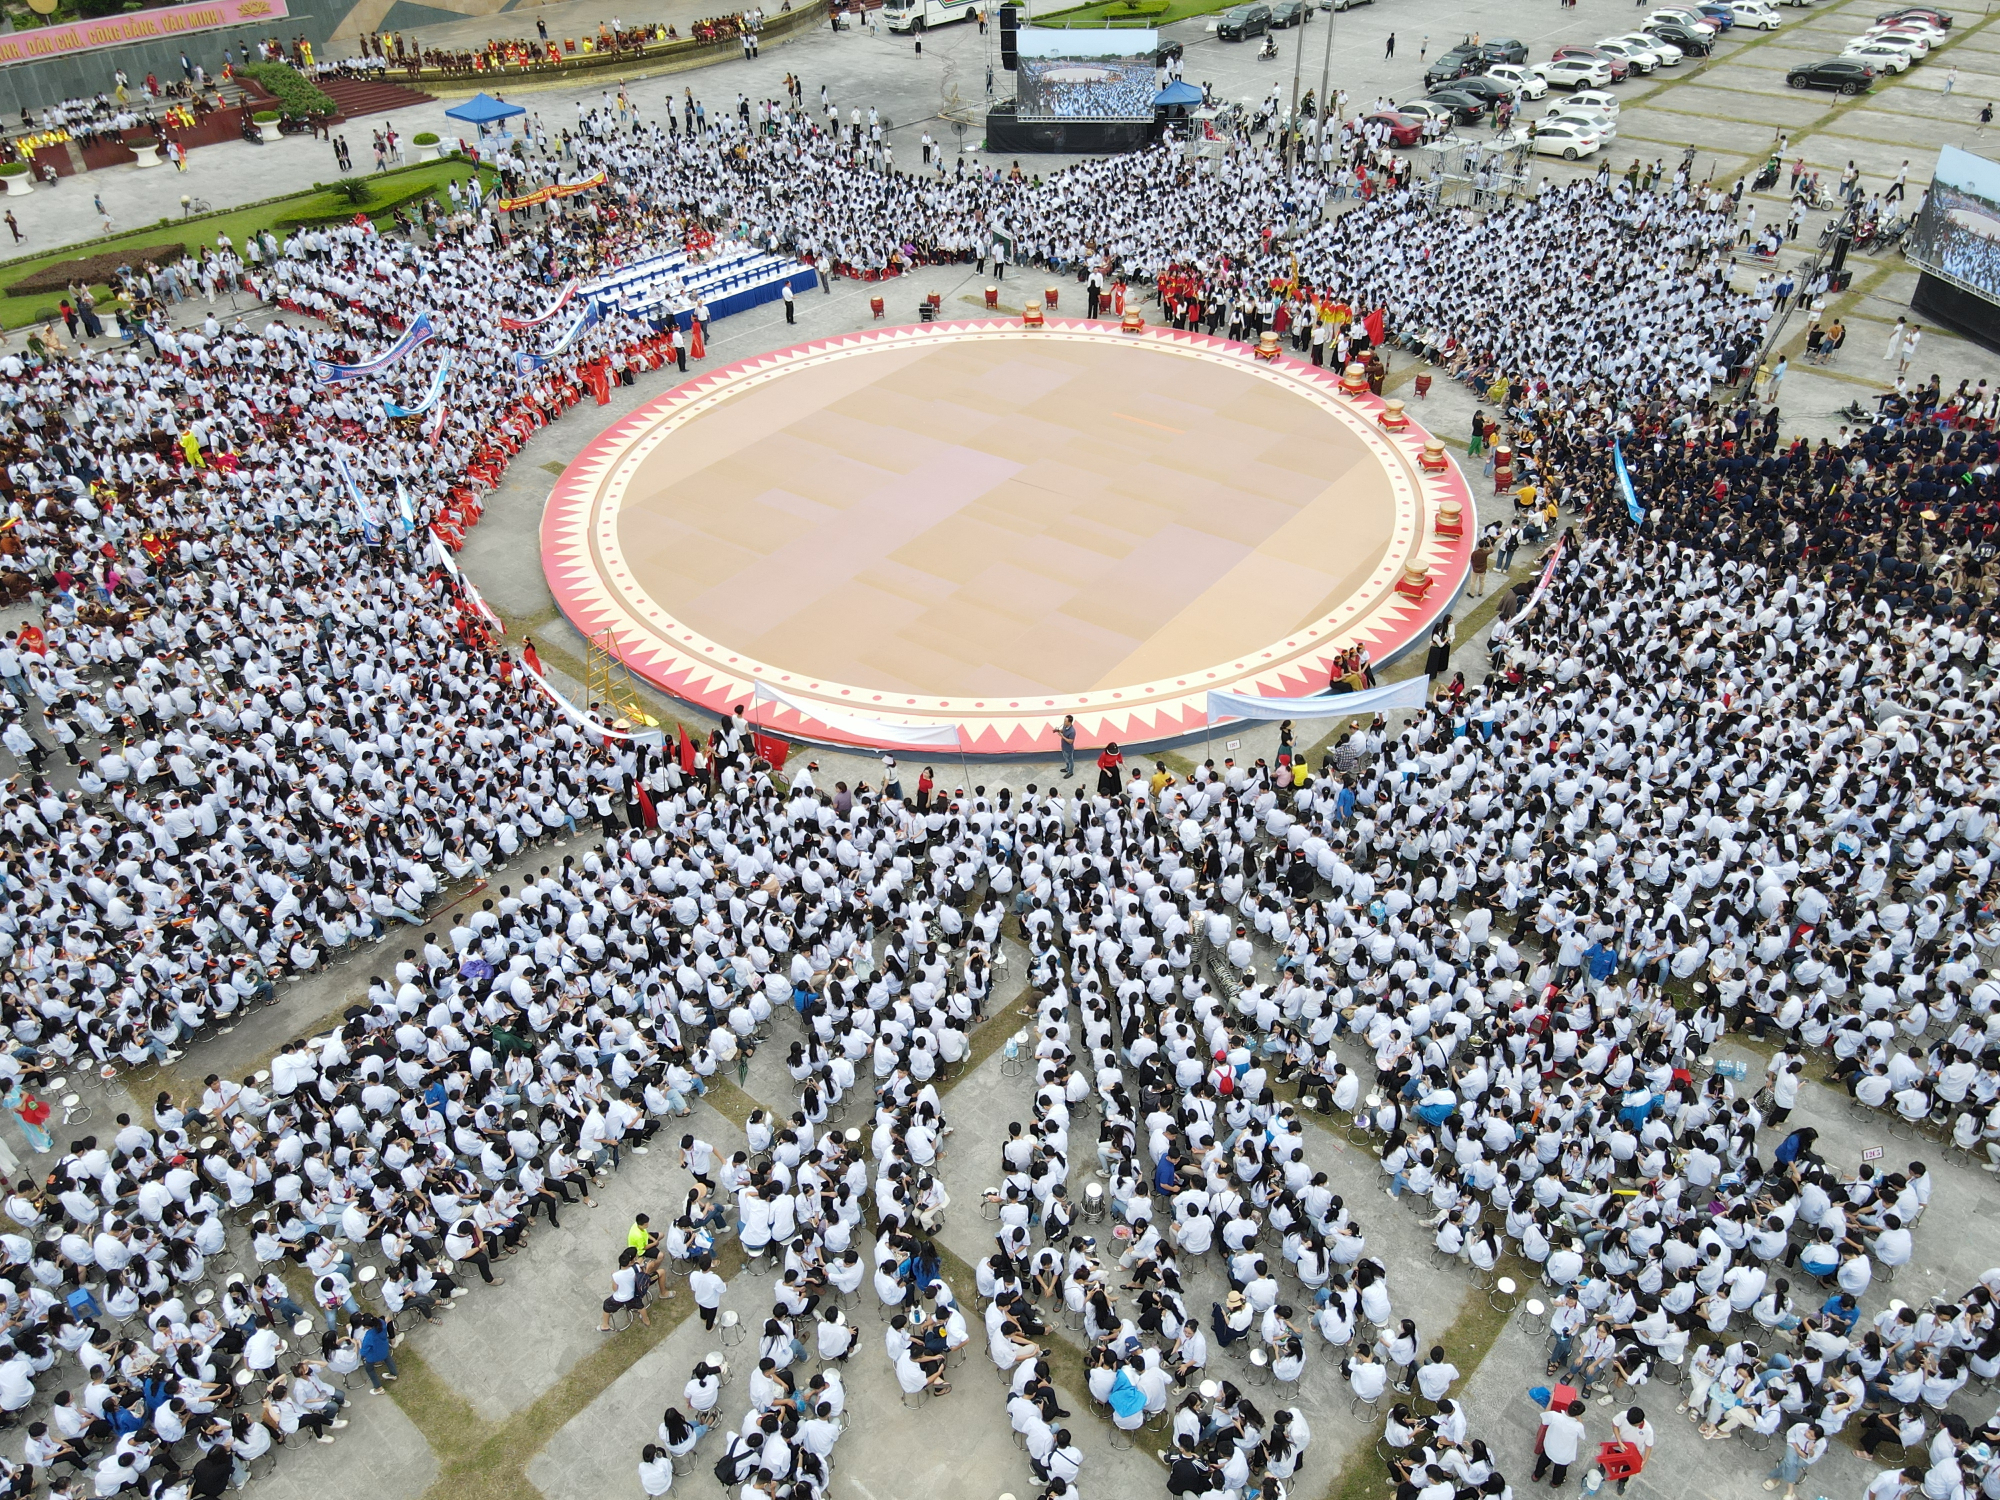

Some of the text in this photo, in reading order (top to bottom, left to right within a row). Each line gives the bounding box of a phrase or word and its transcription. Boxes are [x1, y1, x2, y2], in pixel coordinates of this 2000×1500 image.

[26, 35, 54, 56] DÂN
[55, 27, 87, 50] CHỦ,
[88, 25, 122, 45] CÔNG
[122, 16, 161, 39] BẰNG,
[161, 14, 186, 33] VĂN
[186, 9, 219, 28] MINH
